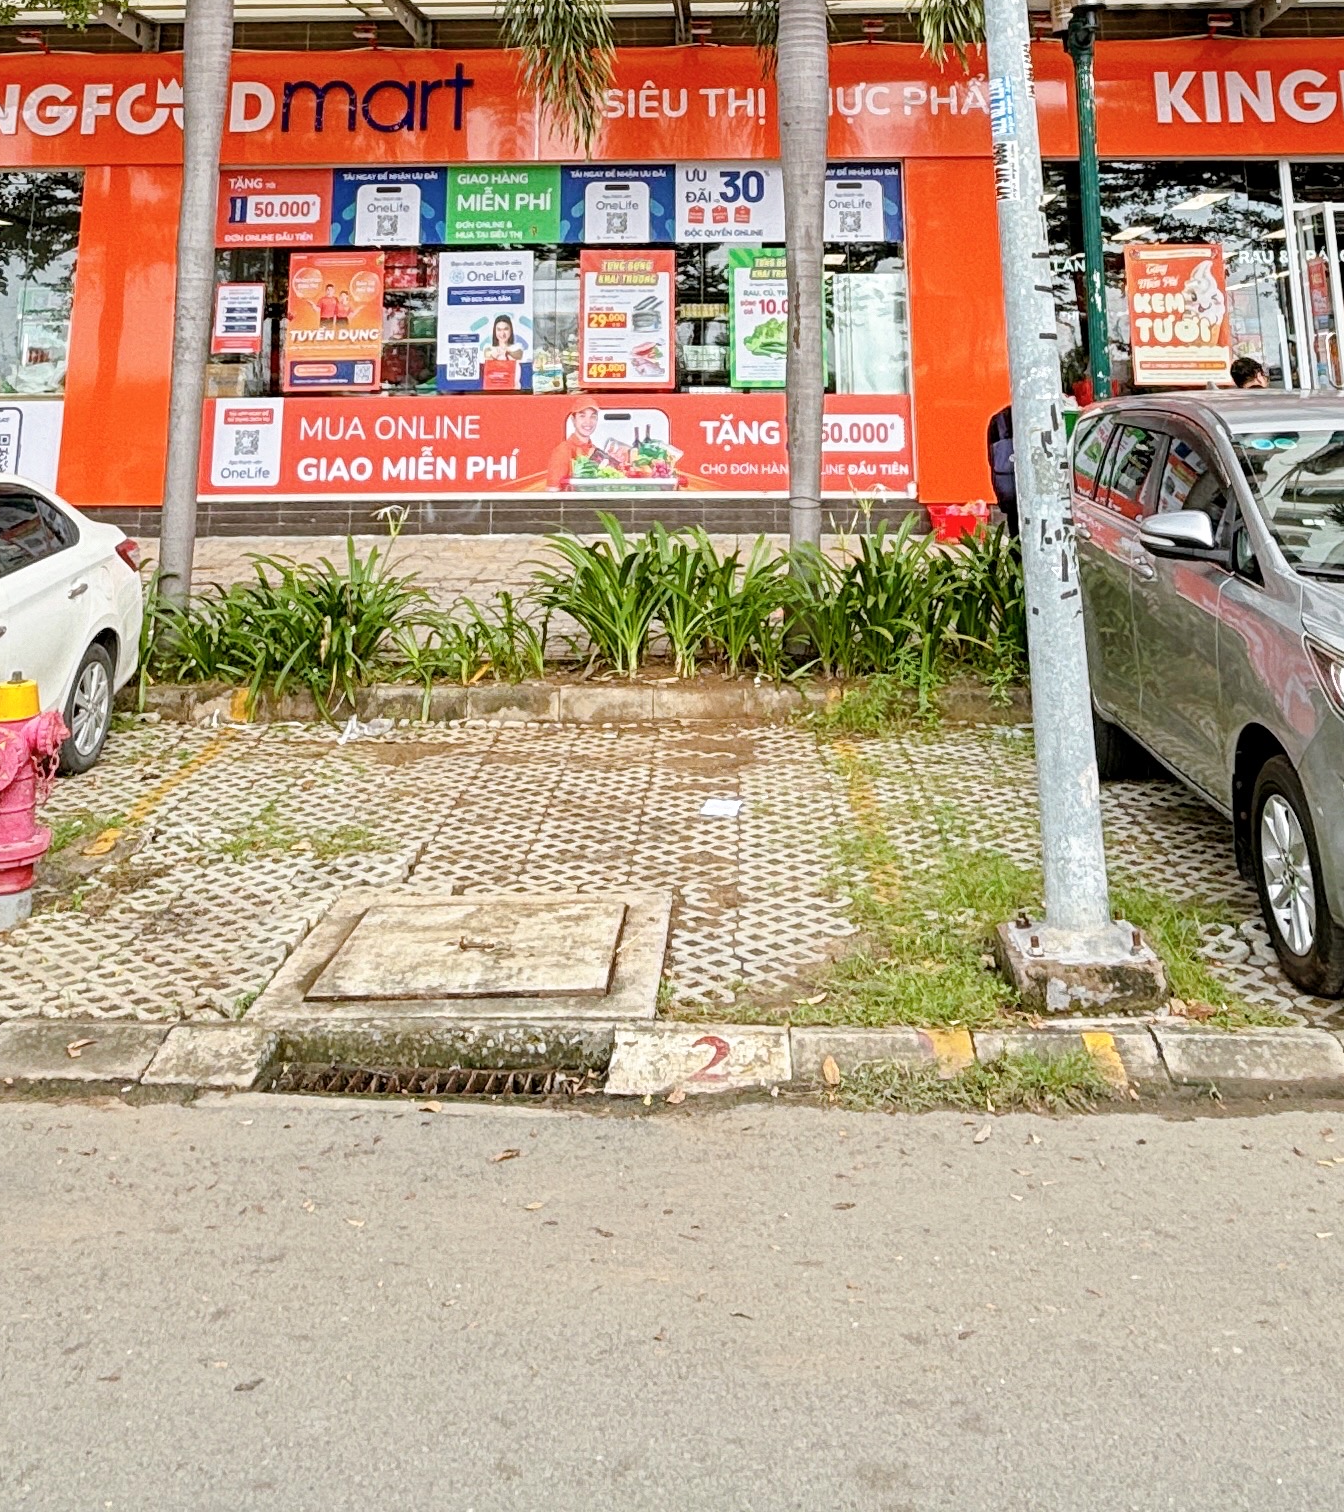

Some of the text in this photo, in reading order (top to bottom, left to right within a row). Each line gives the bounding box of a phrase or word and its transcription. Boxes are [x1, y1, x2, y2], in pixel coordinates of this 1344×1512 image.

[603, 79, 687, 119] SIÊU
[699, 87, 766, 126] THỊ
[903, 73, 991, 117] PHẨ
[457, 170, 528, 185] GIAO HÀNG
[686, 168, 708, 182] ƯU
[228, 177, 263, 192] TẶNG
[457, 187, 553, 212] MIỄN PHÍ
[685, 187, 712, 203] ĐÃI
[367, 202, 410, 214] OneLife
[596, 200, 639, 211] OneLife
[828, 199, 872, 210] OneLife
[684, 227, 703, 237] ĐỘC
[1238, 250, 1274, 264] RAU
[467, 270, 523, 282] OneLife?
[1133, 293, 1185, 314] KEM
[290, 326, 380, 344] TUYỂN DỤNG
[300, 415, 480, 441] MUA ONLINE
[699, 413, 780, 452] TẶNG
[297, 446, 519, 482] GIAO MIỄN PHÍ
[700, 463, 728, 475] CHO
[730, 462, 759, 475] ĐƠN
[761, 461, 789, 475] HÀN
[848, 460, 877, 475] ĐẦU
[879, 460, 909, 475] TIÊN
[220, 467, 270, 480] OneLife
[686, 1035, 732, 1083] 2
